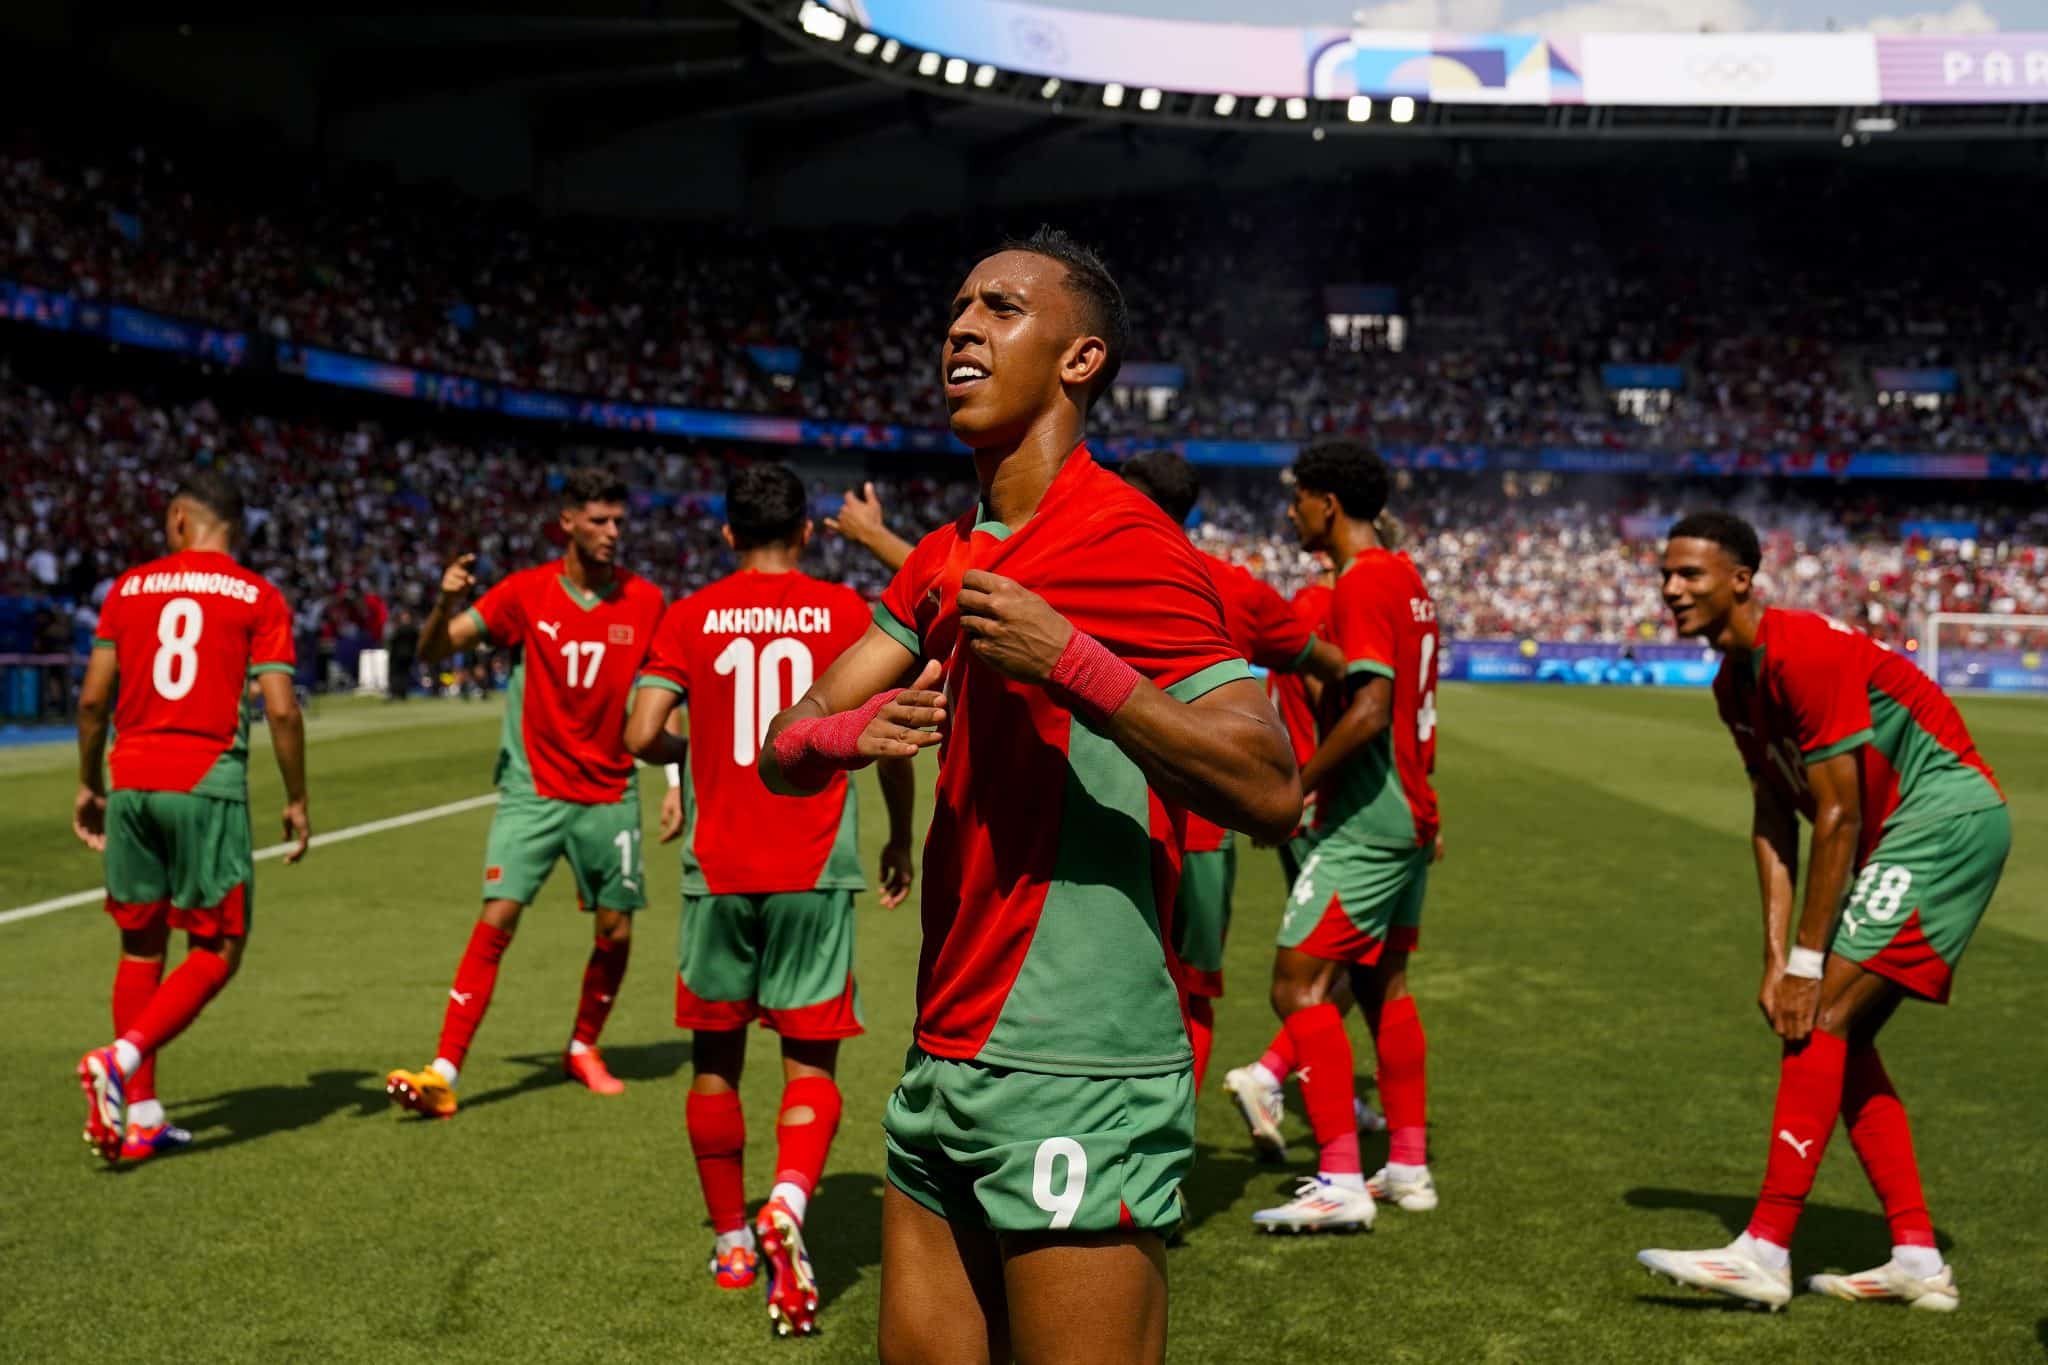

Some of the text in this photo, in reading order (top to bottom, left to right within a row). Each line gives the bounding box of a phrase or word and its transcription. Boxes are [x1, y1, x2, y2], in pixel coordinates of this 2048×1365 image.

[153, 597, 203, 700] 8
[561, 640, 606, 688] 17
[703, 607, 831, 634] AKHONACH
[713, 636, 814, 767] 10
[1033, 1136, 1088, 1229] 9
